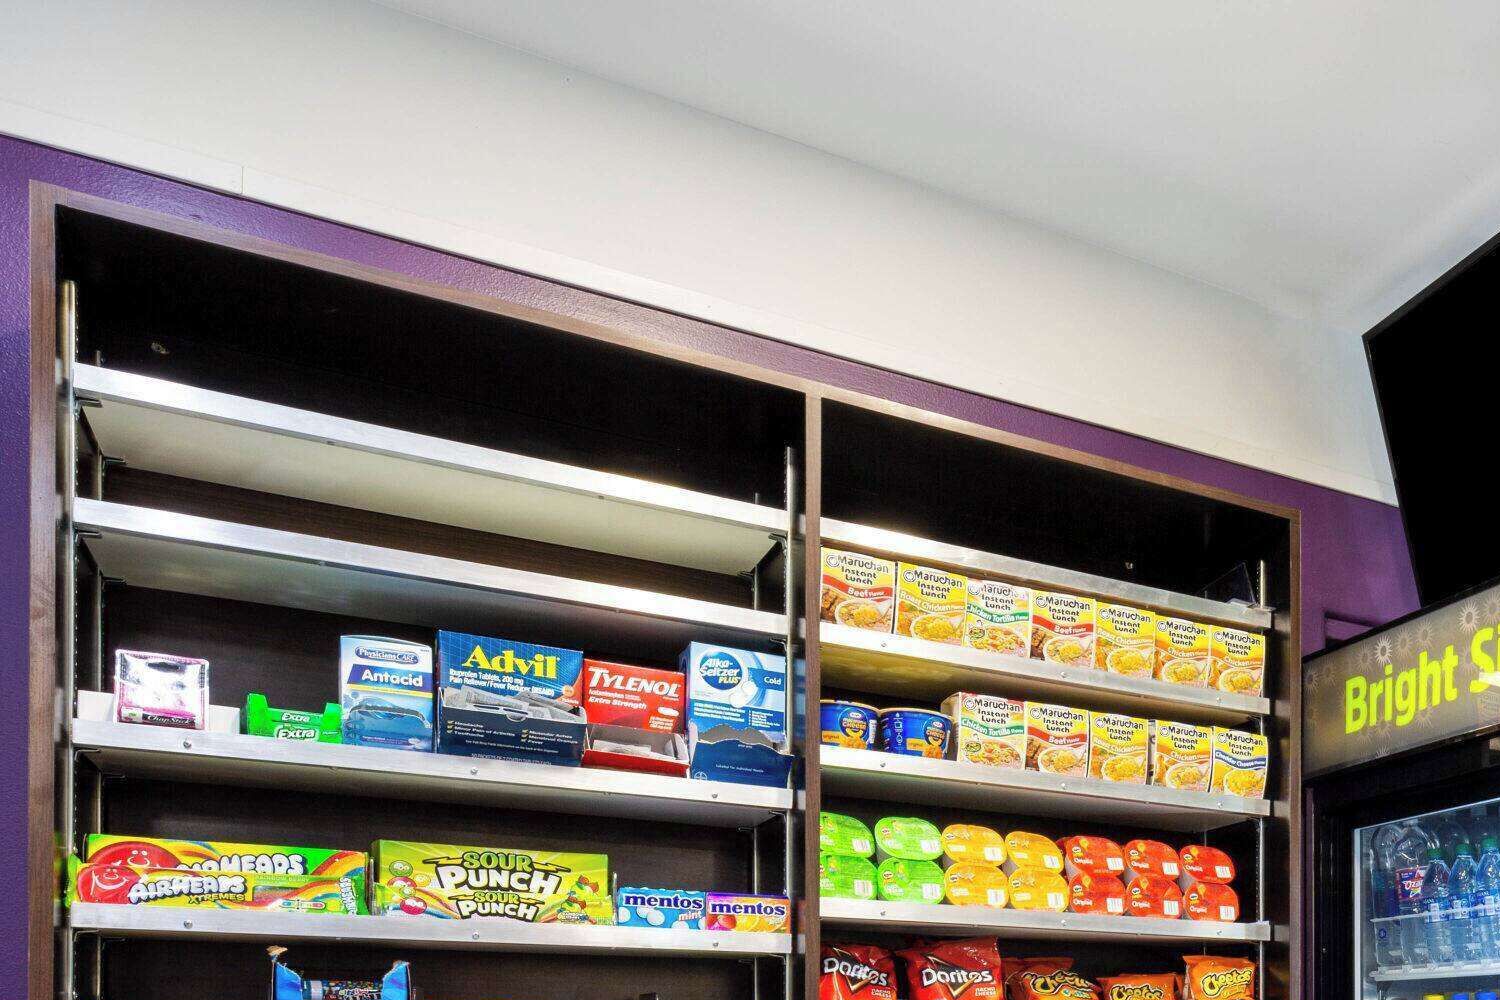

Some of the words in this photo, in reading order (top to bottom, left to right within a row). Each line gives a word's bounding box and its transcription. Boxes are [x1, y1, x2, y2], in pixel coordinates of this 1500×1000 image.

[838, 555, 889, 574] Maruchan
[841, 566, 877, 579] Instant
[914, 570, 963, 588] Maruchan
[845, 574, 874, 586] Lunch
[848, 587, 869, 599] Beef
[917, 581, 951, 594] Instant
[921, 589, 947, 600] Lunch
[982, 594, 1014, 605] Instant
[985, 601, 1011, 612] Lunch
[1046, 596, 1091, 611] Maruchan
[967, 603, 992, 621] Chicken
[1049, 606, 1080, 616] Instant
[1108, 608, 1151, 623] Maruchan
[1052, 613, 1077, 623] Lunch
[1111, 618, 1141, 628] Instant
[1055, 625, 1072, 635] Beef
[1115, 625, 1138, 634] Lunch
[1166, 620, 1206, 636] Maruchan
[1168, 631, 1197, 641] Instant
[1171, 638, 1193, 647] Lunch
[1222, 631, 1261, 646] Maruchan
[1225, 641, 1251, 650] Instant
[1227, 647, 1249, 657] Lunch
[462, 645, 557, 679] Advil
[361, 668, 423, 688] Antacid
[699, 666, 740, 678] Seltzer
[588, 666, 681, 698] TYLENOL
[718, 676, 741, 684] PLUS
[764, 676, 781, 686] Cold
[1345, 645, 1458, 733] Bright
[588, 697, 611, 706] Extra
[612, 699, 647, 710] Strength
[975, 698, 1021, 712] Maruchan
[281, 712, 310, 722] Extra
[977, 708, 1010, 719] Instant
[981, 715, 1007, 725] Lunch
[1040, 708, 1084, 721] Maruchan
[962, 718, 988, 734] Chicken
[1043, 718, 1074, 728] Instant
[1046, 724, 1070, 734] Lunch
[1103, 717, 1144, 731] Maruchan
[277, 727, 315, 740] Extra
[1106, 727, 1135, 736] Instant
[1109, 733, 1132, 742] Lunch
[1168, 725, 1208, 739] Maruchan
[1049, 735, 1066, 745] Beef
[1171, 735, 1198, 745] Instant
[1174, 741, 1196, 751] Lunch
[1225, 733, 1264, 746] Maruchan
[1228, 742, 1256, 751] Instant
[1231, 748, 1252, 757] Lunch
[462, 851, 532, 871] SOUR
[435, 866, 562, 895] PUNCH
[129, 875, 247, 904] AIRHEADS
[474, 891, 519, 904] SOUR
[624, 894, 703, 910] mentos
[457, 900, 544, 922] PUNCH
[710, 902, 786, 917] mentos
[679, 911, 704, 922] mint
[823, 957, 889, 987] Doritos
[922, 968, 997, 987] Doritos
[1202, 969, 1253, 997] Cheetos
